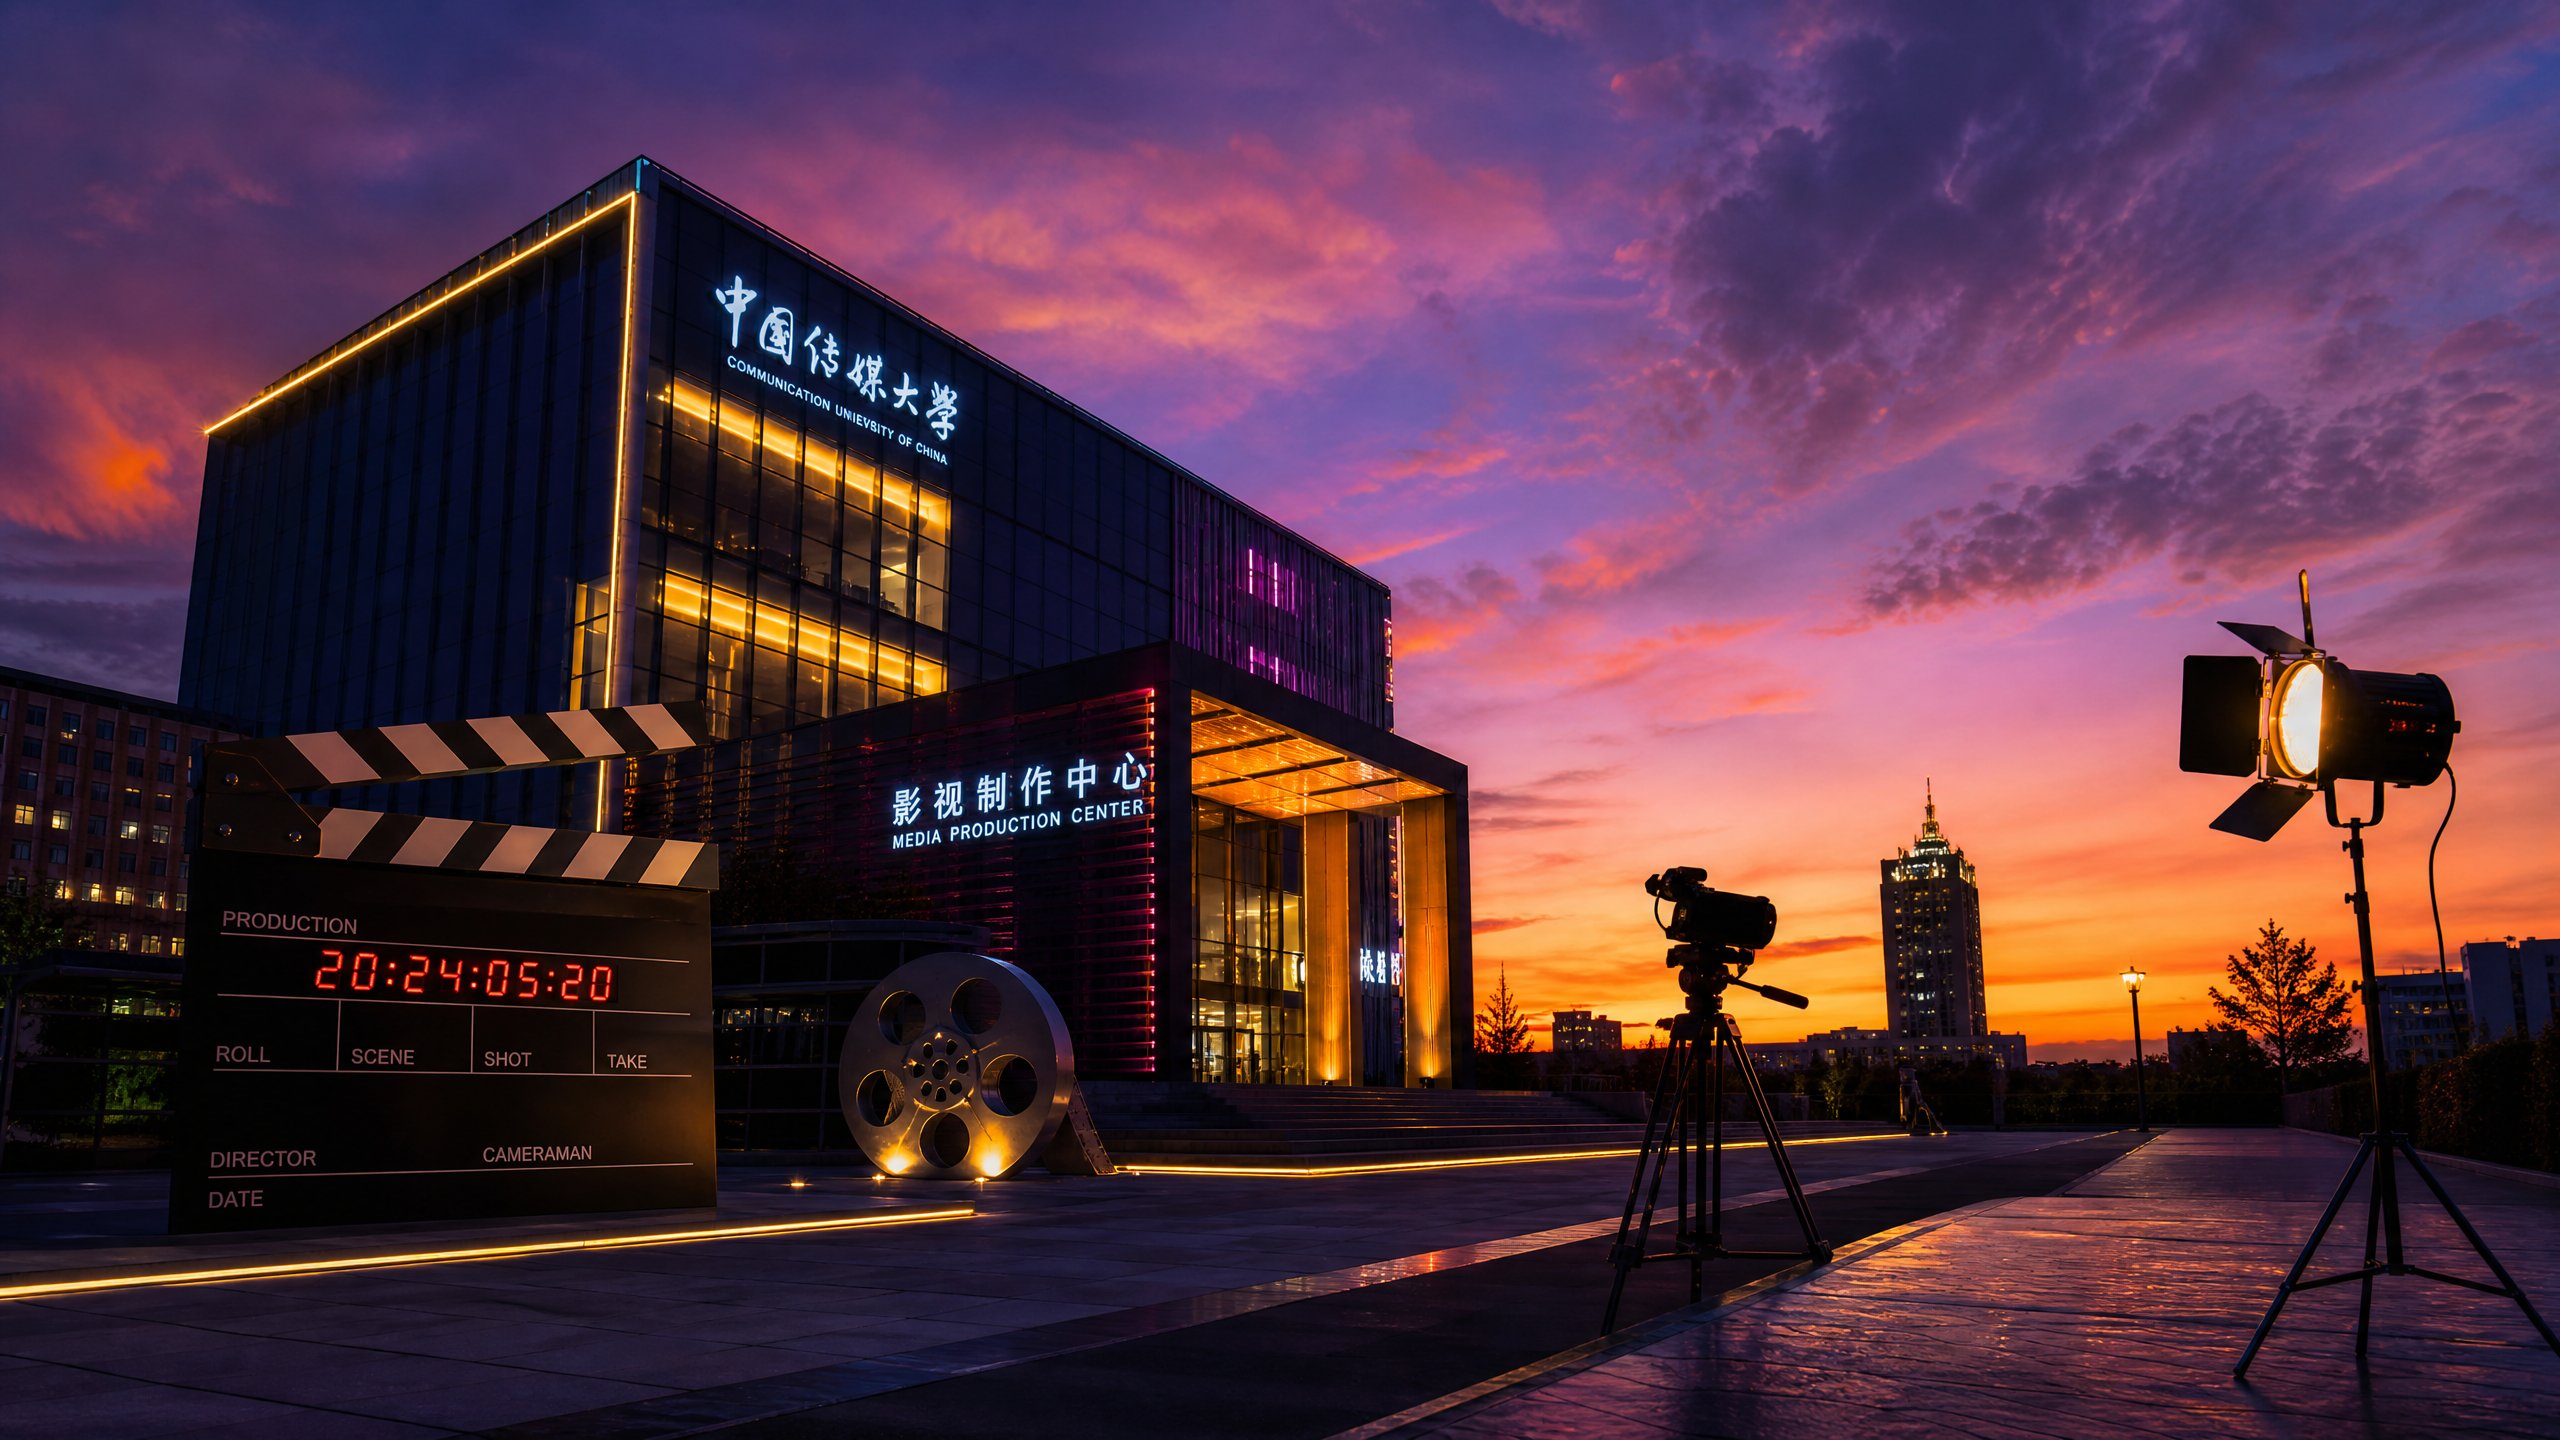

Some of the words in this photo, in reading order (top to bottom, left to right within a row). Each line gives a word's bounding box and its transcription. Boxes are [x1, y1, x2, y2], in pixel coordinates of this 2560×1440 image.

[727, 355, 831, 412] COMMUNICATION
[898, 433, 912, 448] OF
[915, 443, 948, 466] CHINA
[892, 751, 1147, 826] 影视制作中心
[892, 829, 942, 850] MEDIA
[950, 811, 1061, 842] PRODUCTION
[1071, 799, 1144, 824] CENTER
[221, 911, 357, 935] PRODUCTION
[315, 951, 612, 1001] 20:24:05:20
[216, 1045, 270, 1063] ROLL
[351, 1048, 415, 1065] SCENE
[484, 1051, 532, 1067] SHOT
[607, 1053, 648, 1070] TAKE
[210, 1150, 317, 1168] DIRECTOR
[483, 1144, 592, 1163] CAMERAMAN
[208, 1190, 263, 1209] DATE
